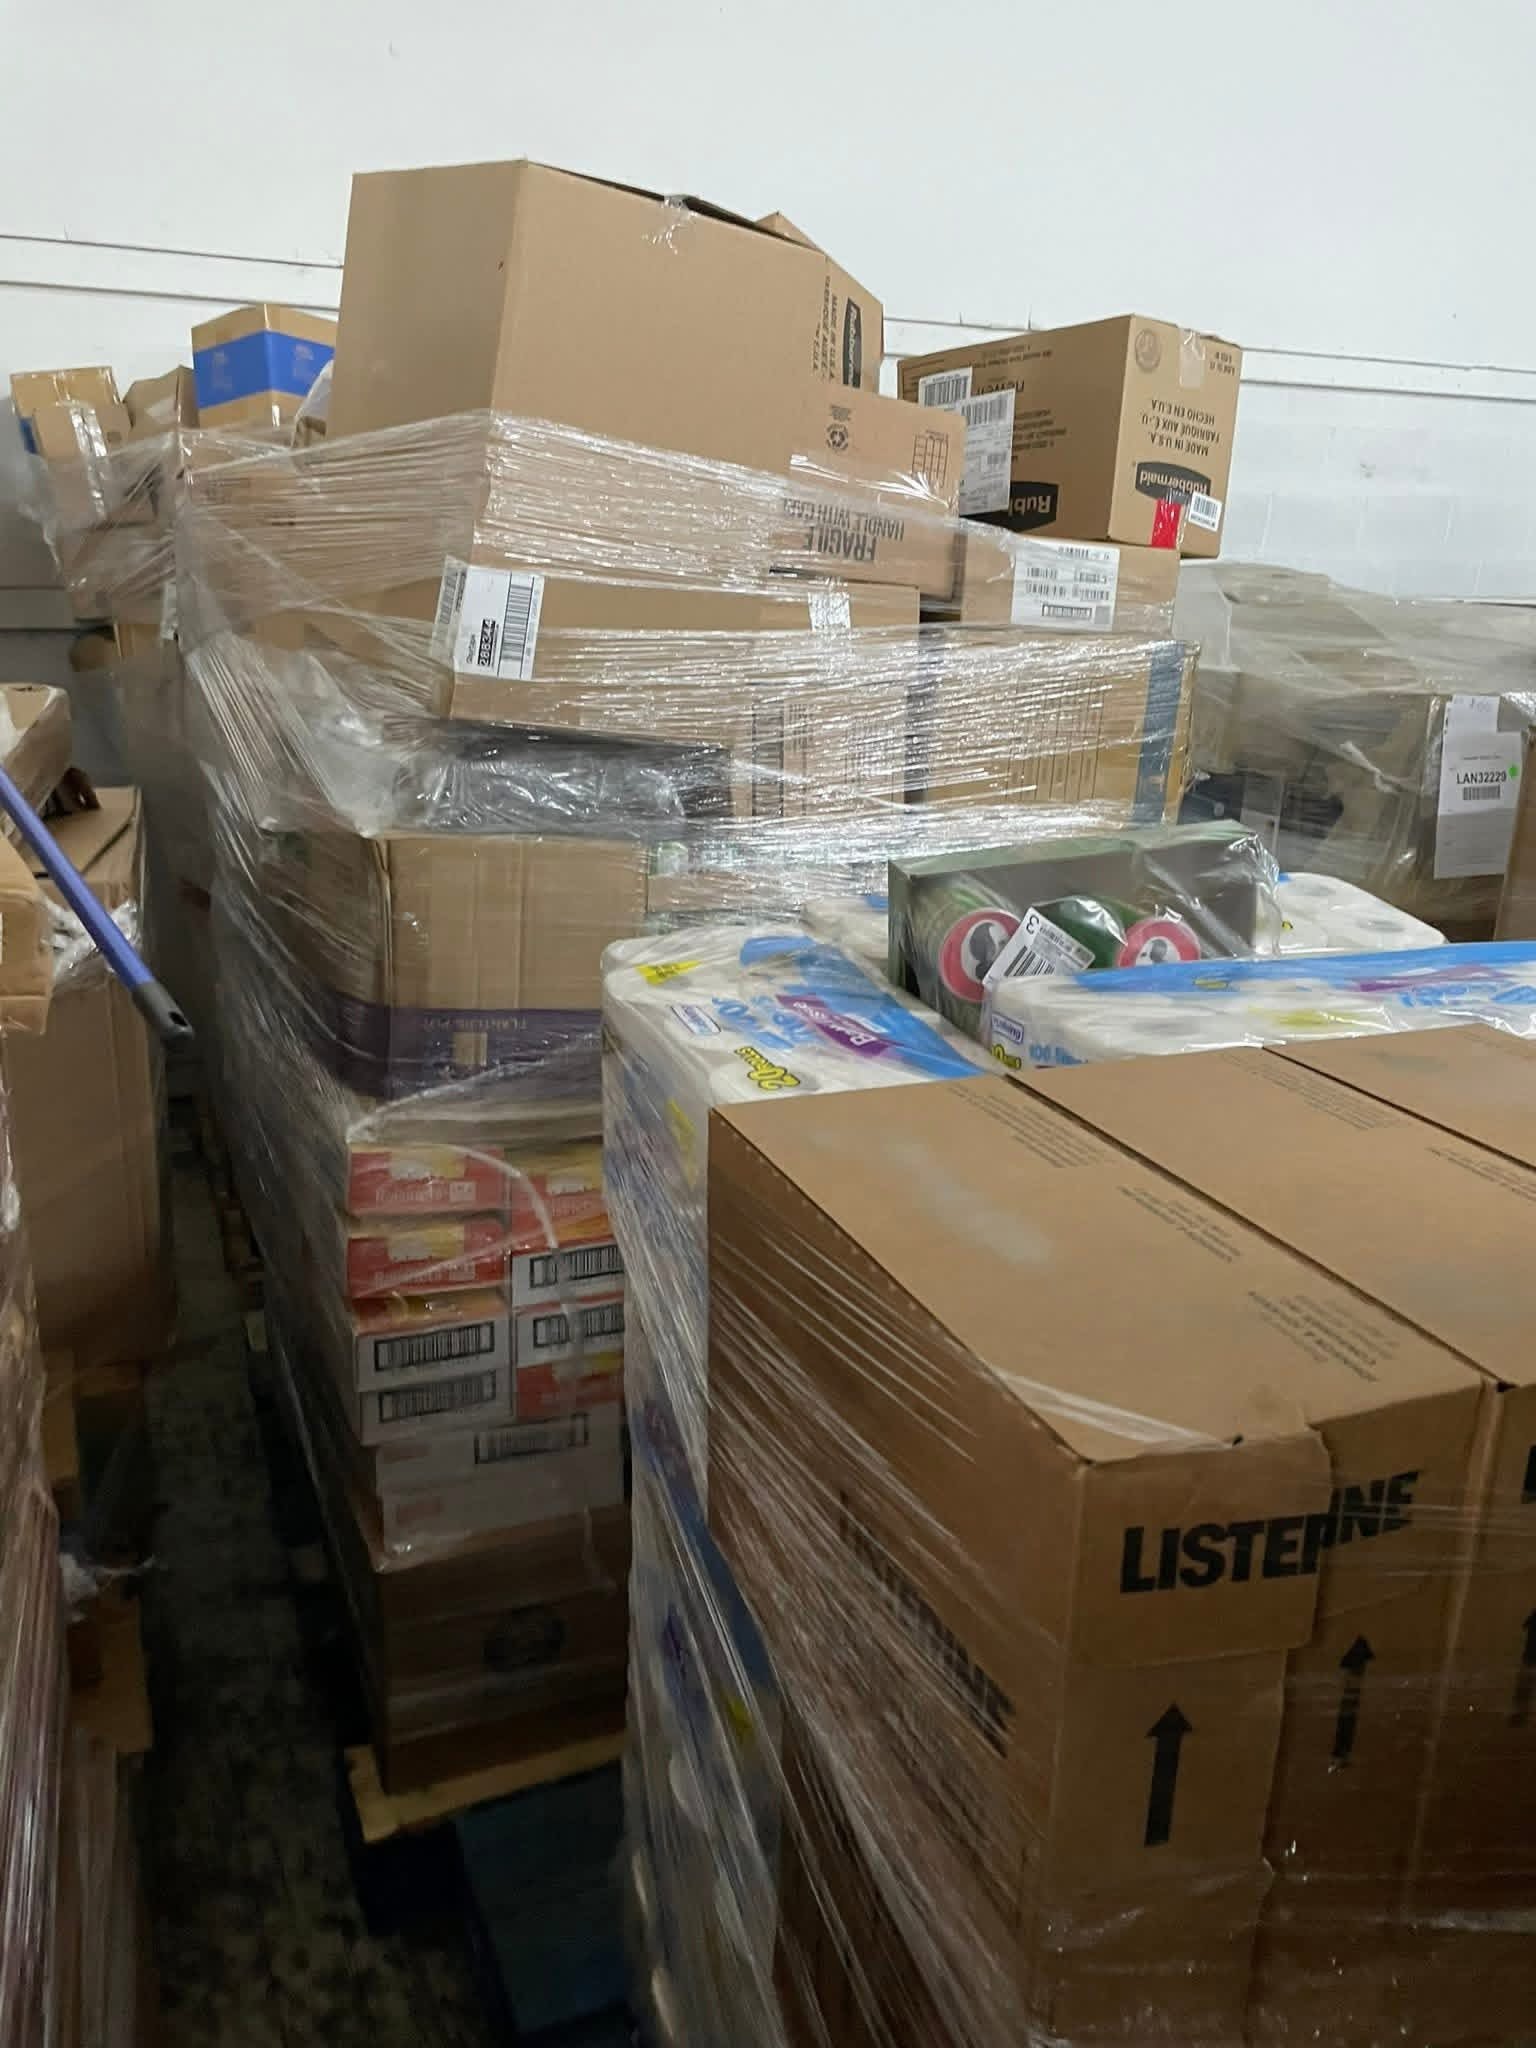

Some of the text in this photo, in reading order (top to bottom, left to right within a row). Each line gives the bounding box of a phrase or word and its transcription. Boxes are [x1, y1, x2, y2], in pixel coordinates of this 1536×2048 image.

[1174, 404, 1186, 417] EN
[1187, 408, 1215, 425] HECHO
[1161, 417, 1179, 433] AUX
[1180, 422, 1220, 444] FABRIQUÉ
[1174, 438, 1184, 451] IN
[1186, 444, 1209, 457] MADE
[817, 503, 850, 530] WITH
[853, 511, 905, 542] HANDLE
[802, 525, 877, 562] FRAGILE
